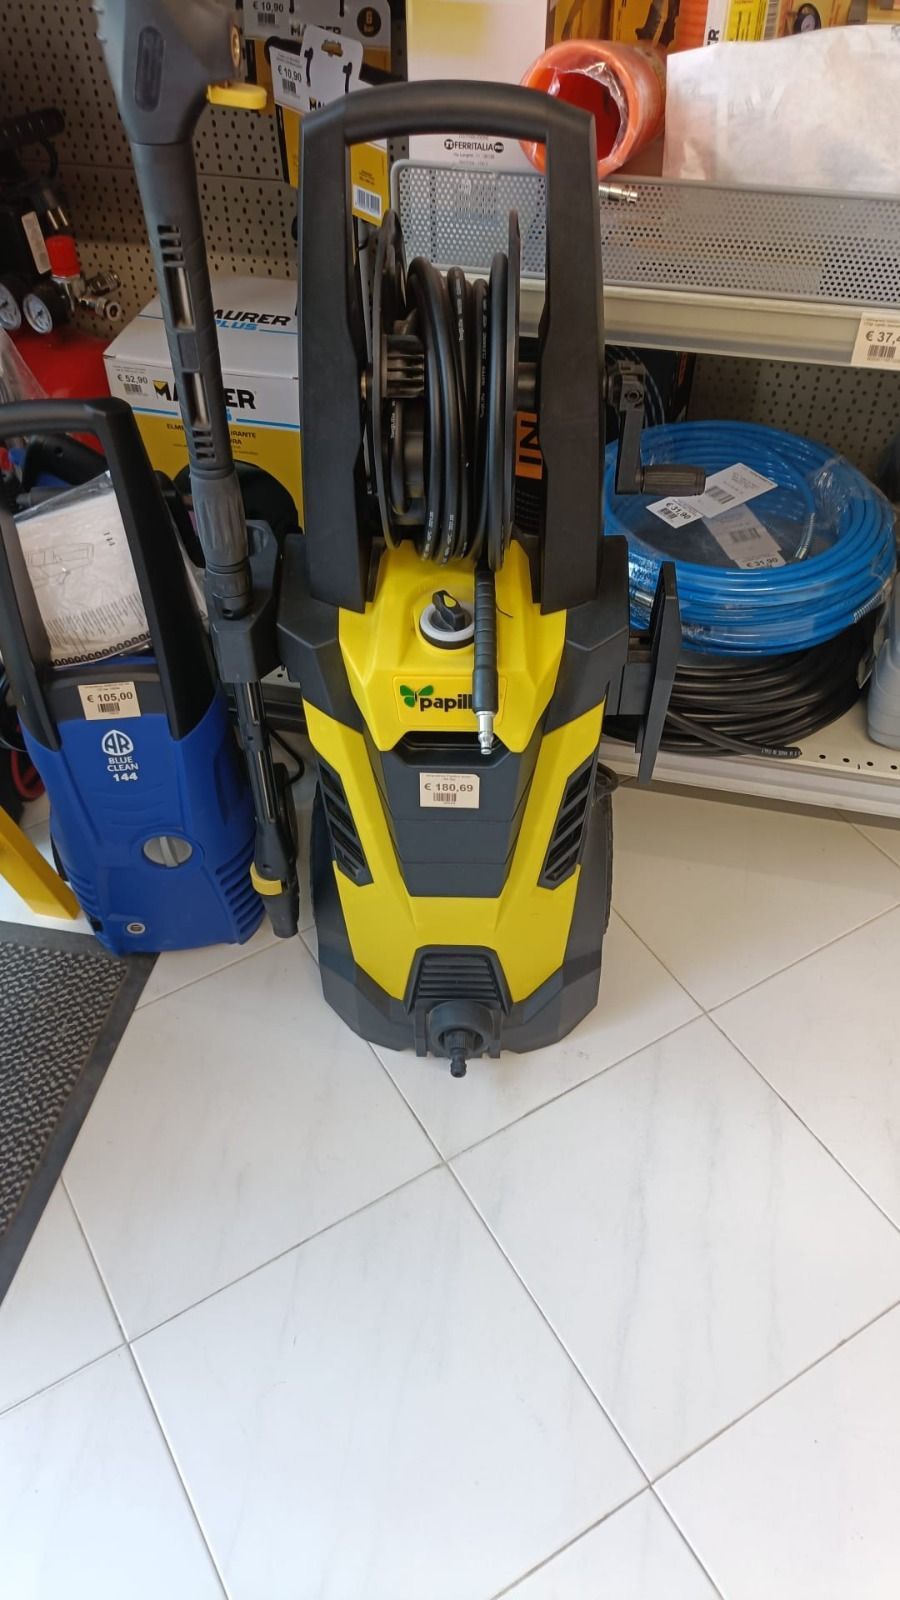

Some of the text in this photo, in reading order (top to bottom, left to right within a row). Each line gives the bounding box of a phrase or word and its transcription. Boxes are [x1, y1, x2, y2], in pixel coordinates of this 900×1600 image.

[262, 1, 284, 13] 10,90
[278, 65, 302, 82] € 10,90
[454, 140, 493, 152] FERRITALIA
[213, 309, 291, 326] AURER
[865, 331, 875, 342] €
[126, 374, 148, 384] 52,90
[87, 691, 133, 703] € 105,00
[420, 694, 474, 712] papill
[103, 731, 132, 755] AR
[108, 756, 133, 765] BLUE
[107, 763, 139, 772] CLEAN
[113, 772, 138, 782] 144
[424, 782, 474, 793] € 180,69
